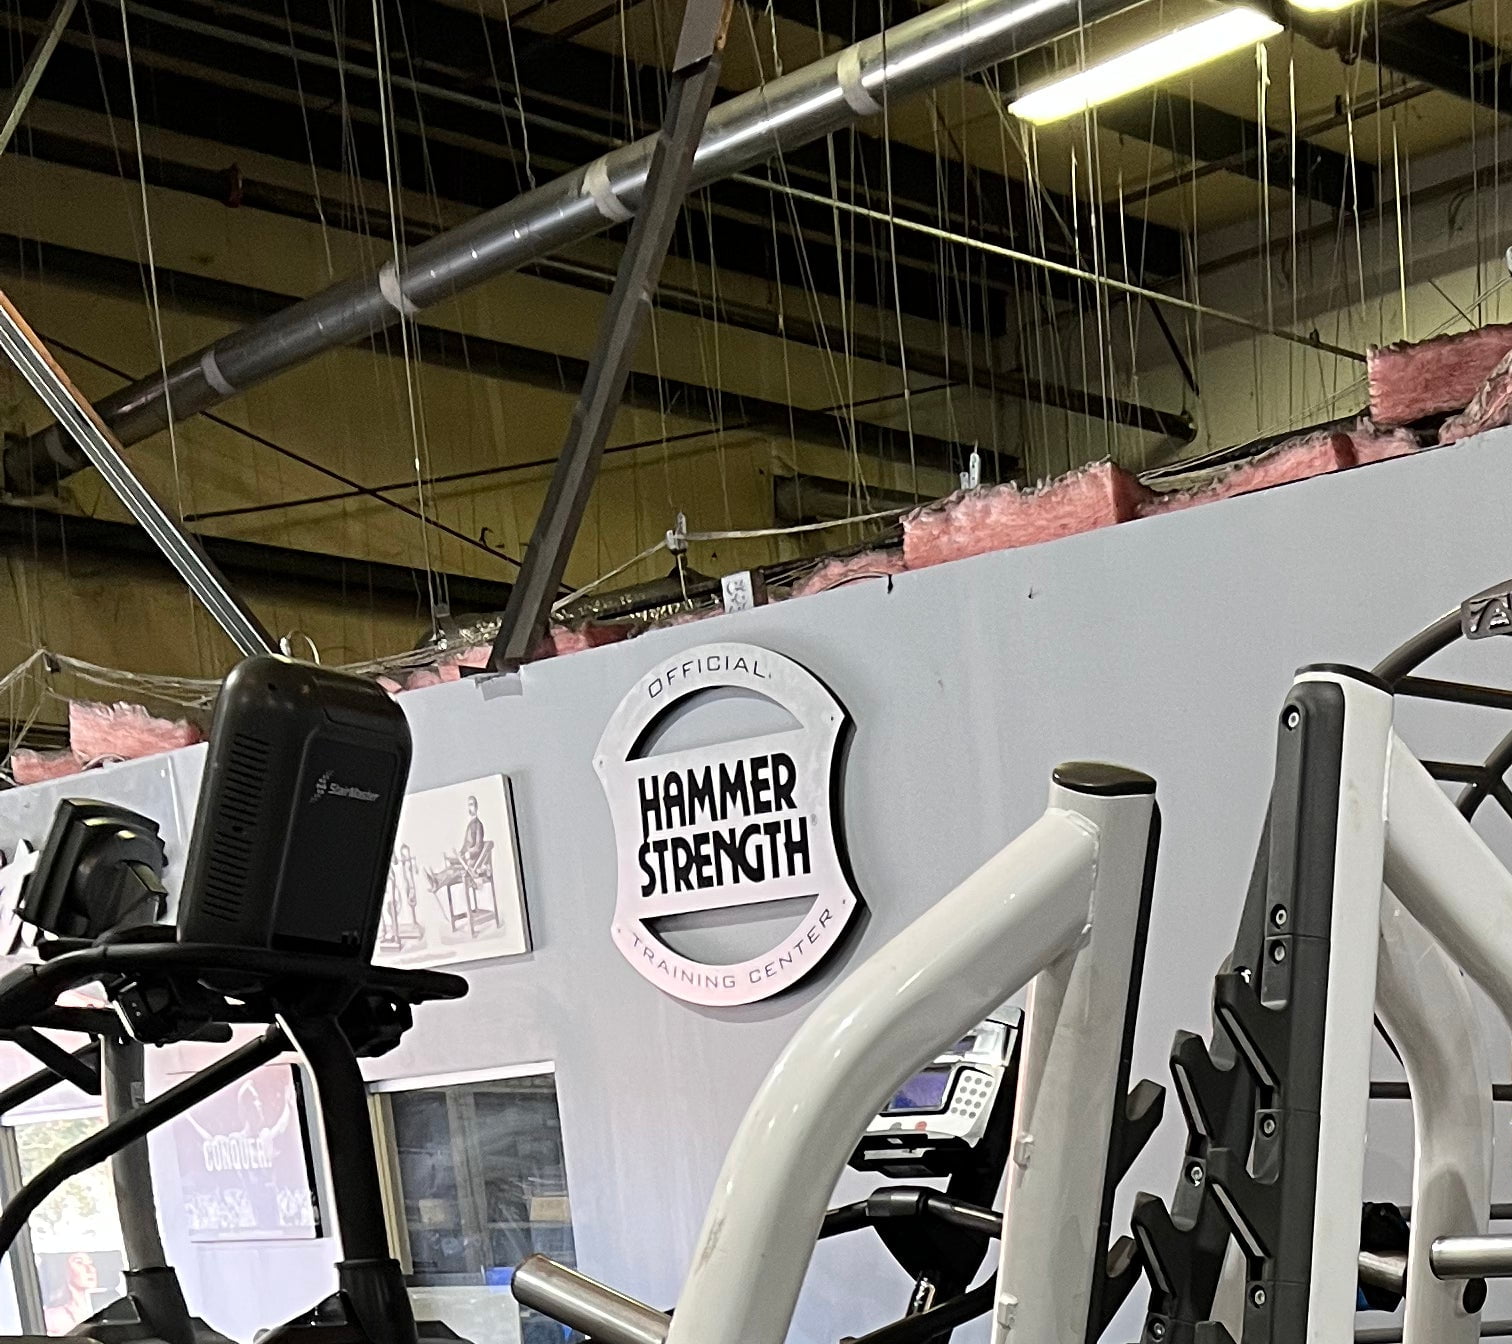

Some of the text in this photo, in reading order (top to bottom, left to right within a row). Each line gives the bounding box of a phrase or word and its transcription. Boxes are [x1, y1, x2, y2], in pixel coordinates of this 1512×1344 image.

[648, 655, 766, 699] OFFICIAL
[637, 752, 798, 835] HAMMER
[637, 816, 812, 898] STRENGTH
[631, 908, 833, 990] TRAINING CENTER
